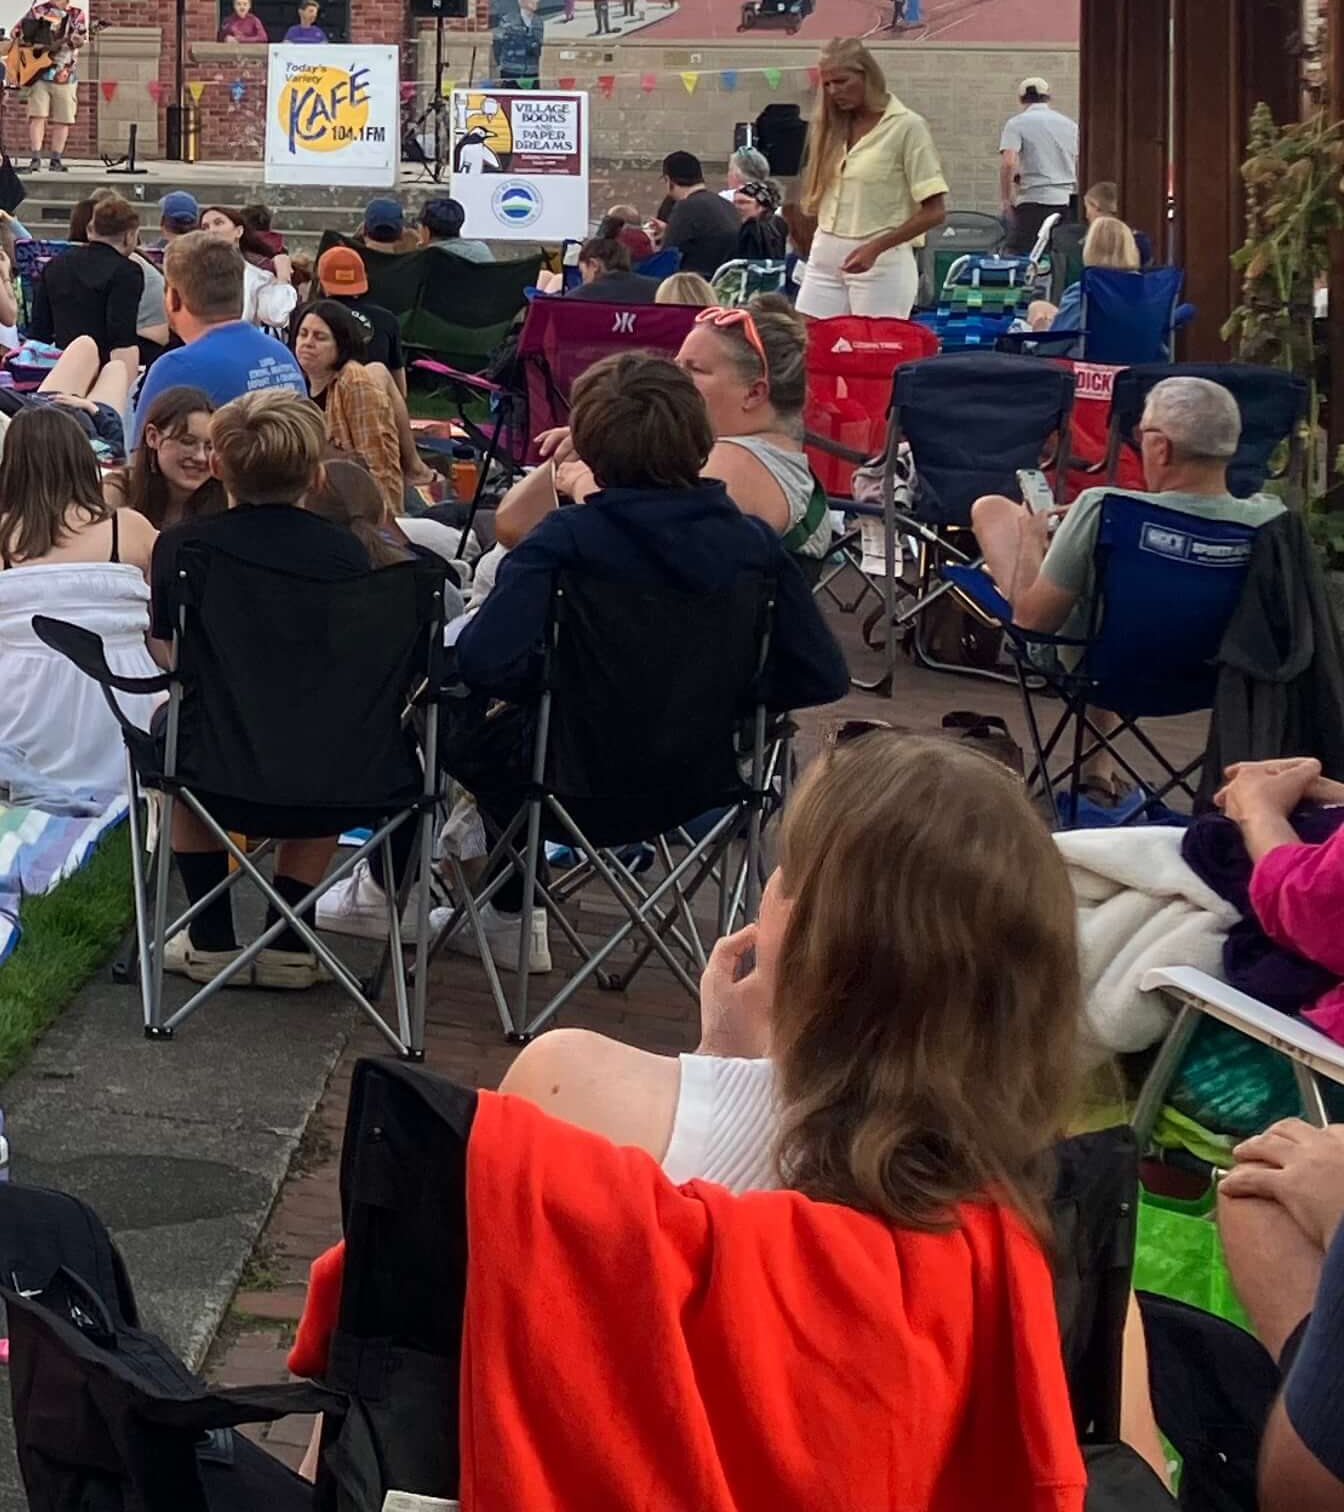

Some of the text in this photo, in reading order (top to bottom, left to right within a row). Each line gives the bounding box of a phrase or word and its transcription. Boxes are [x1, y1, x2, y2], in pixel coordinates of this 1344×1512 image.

[286, 61, 328, 73] Today's
[285, 73, 323, 85] Variety
[514, 103, 570, 113] VILLAGE
[521, 114, 567, 123] BOOKS
[522, 130, 566, 140] PAPER
[514, 140, 573, 151] DREAMS
